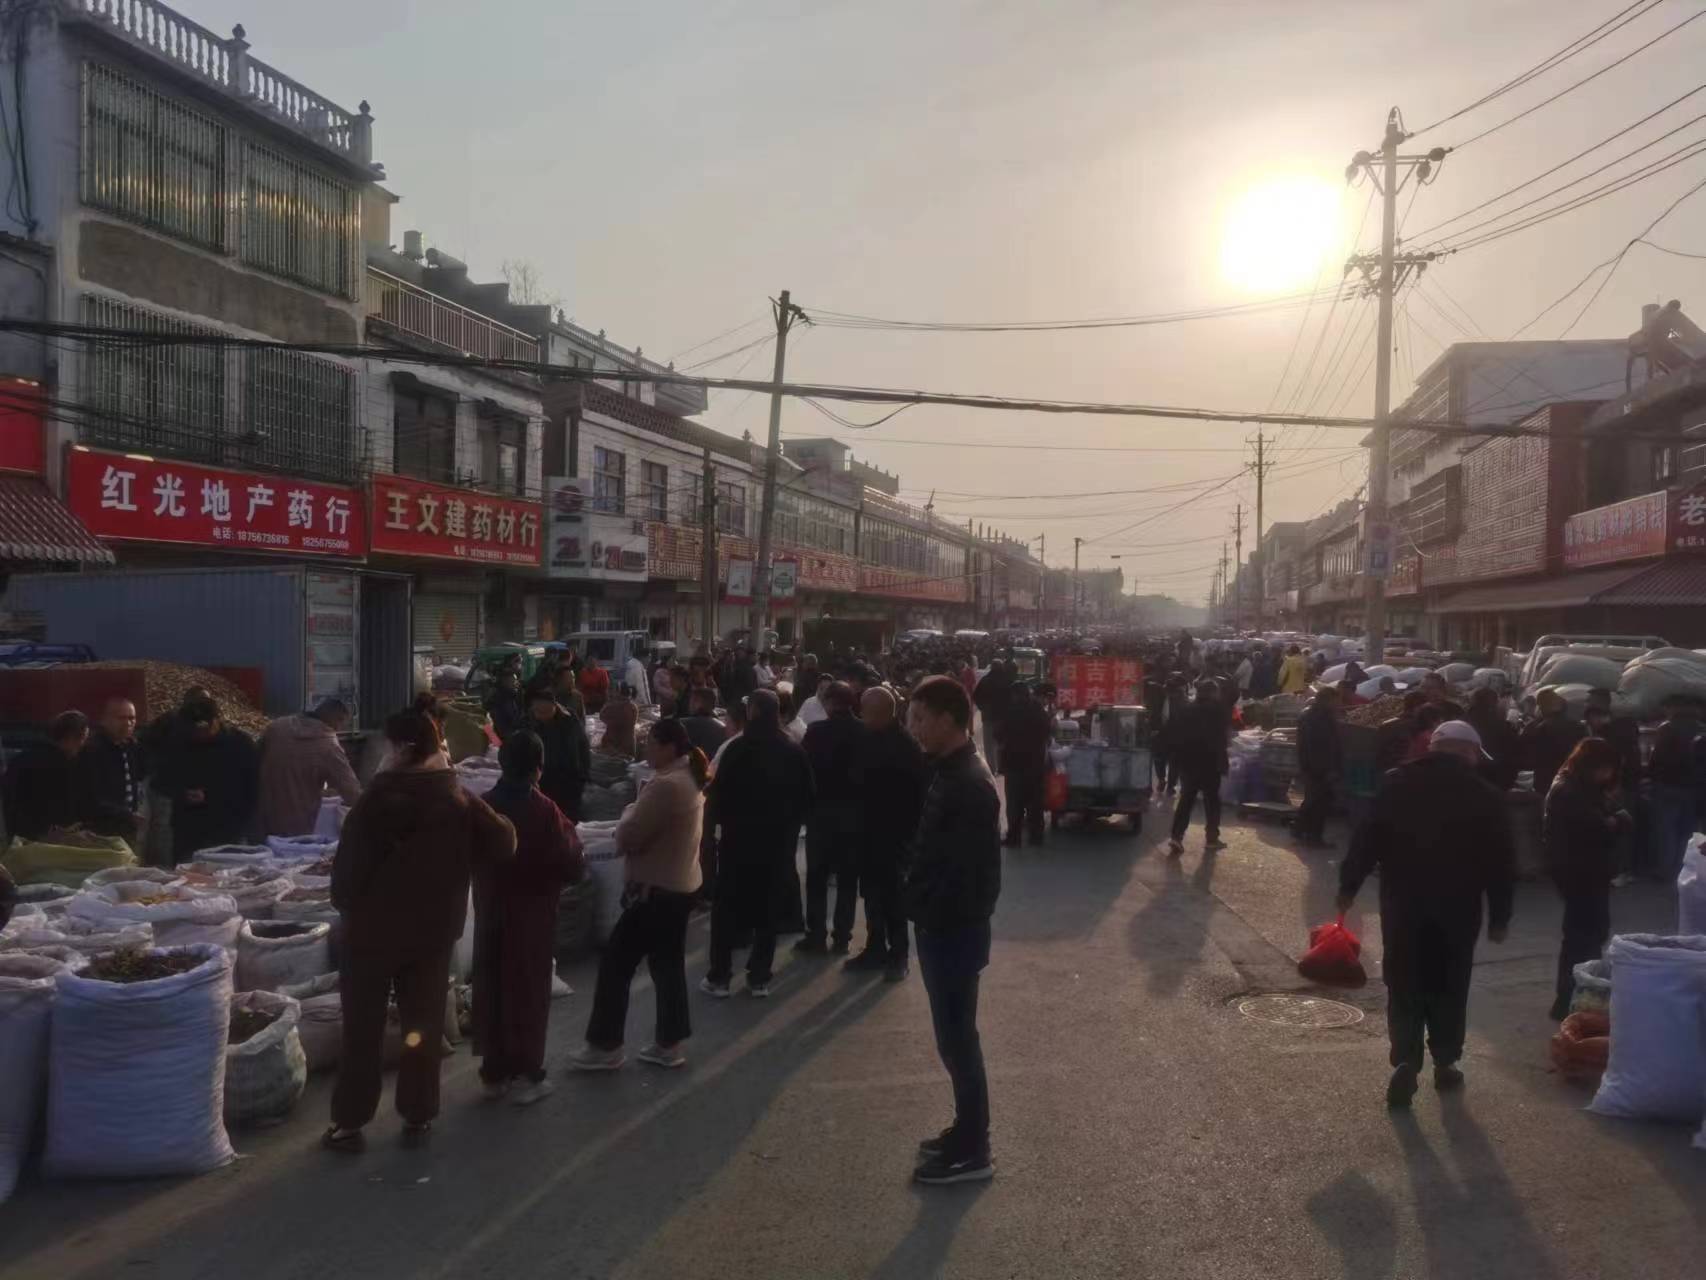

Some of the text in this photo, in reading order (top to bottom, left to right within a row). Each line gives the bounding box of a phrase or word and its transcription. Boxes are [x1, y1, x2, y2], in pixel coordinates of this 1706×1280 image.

[101, 465, 351, 534] 红光地产药行
[385, 491, 539, 547] 王文建药材行
[1678, 493, 1706, 526] 老
